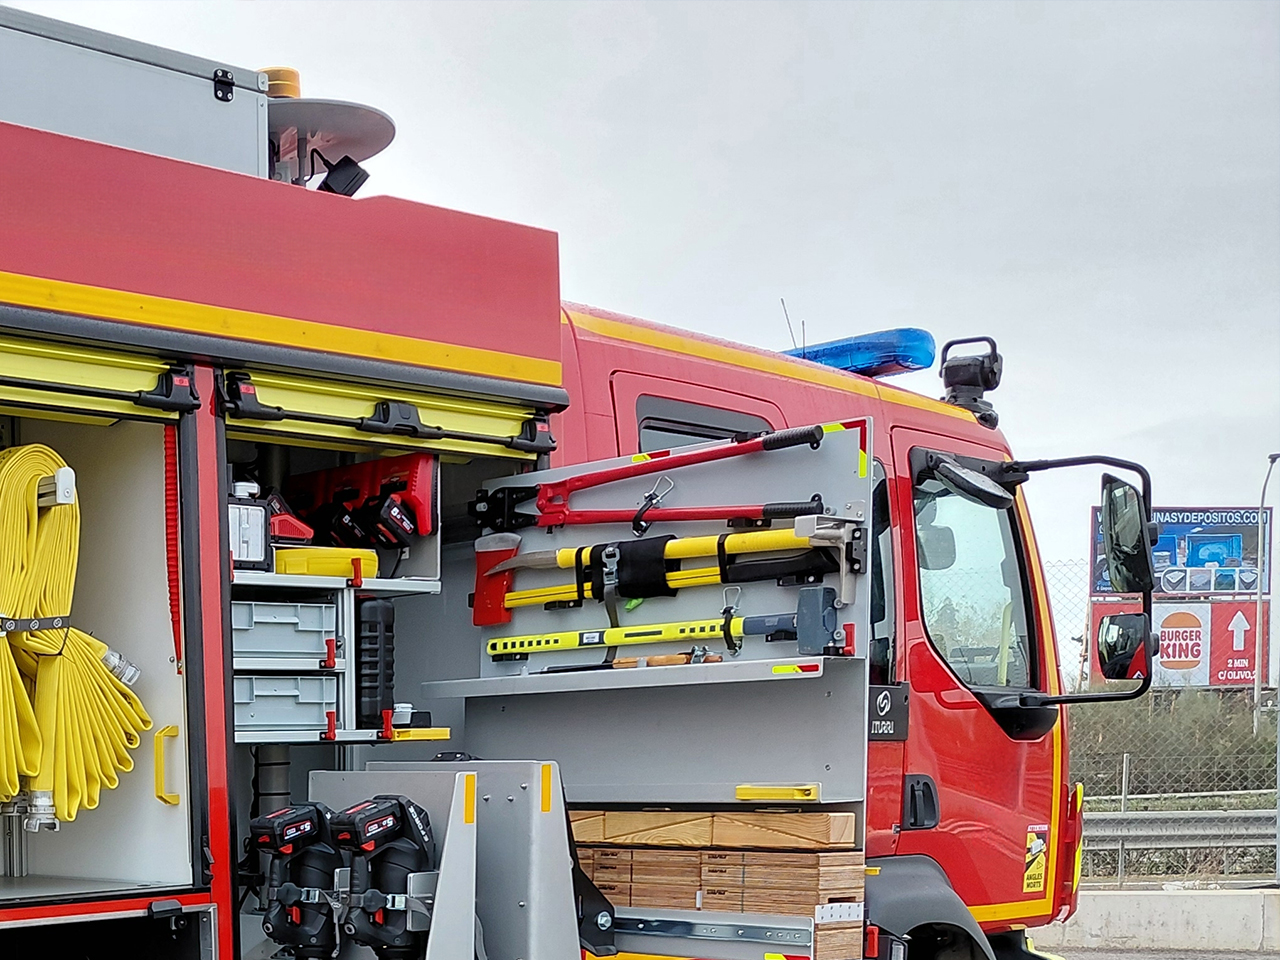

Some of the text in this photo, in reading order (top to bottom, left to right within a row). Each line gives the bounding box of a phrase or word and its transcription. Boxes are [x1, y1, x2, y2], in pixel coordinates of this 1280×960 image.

[1160, 630, 1201, 641] BURGER
[1160, 642, 1201, 659] KING
[1227, 659, 1249, 668] 2 MIN
[1026, 873, 1043, 881] ANGLES
